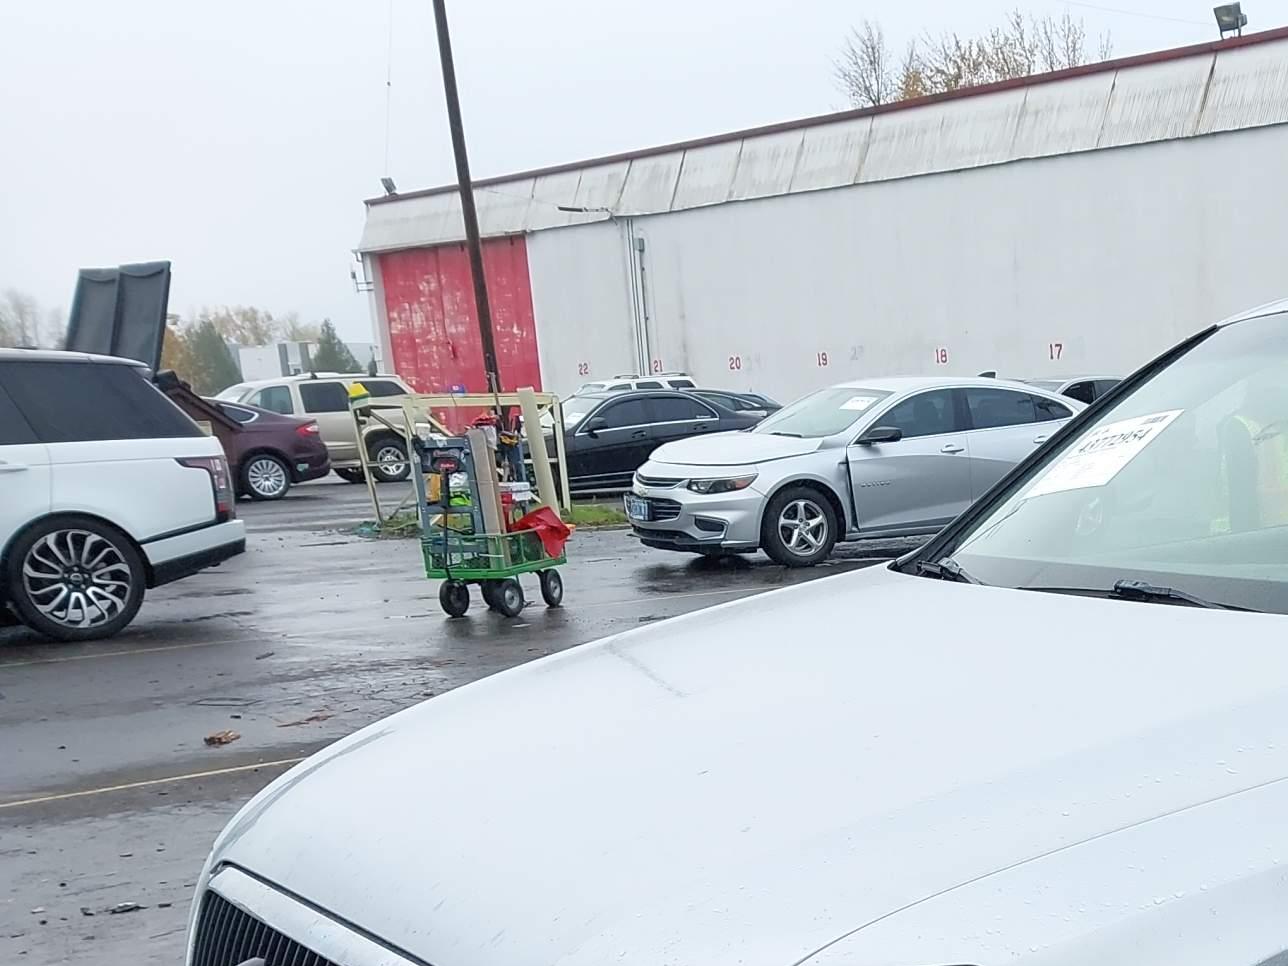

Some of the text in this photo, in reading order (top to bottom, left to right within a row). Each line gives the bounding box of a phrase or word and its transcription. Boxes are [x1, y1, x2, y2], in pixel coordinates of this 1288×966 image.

[935, 348, 948, 363] 18
[1049, 343, 1063, 360] 17
[653, 360, 663, 372] 21
[728, 356, 742, 370] 20
[817, 352, 828, 366] 19
[578, 362, 589, 375] 22
